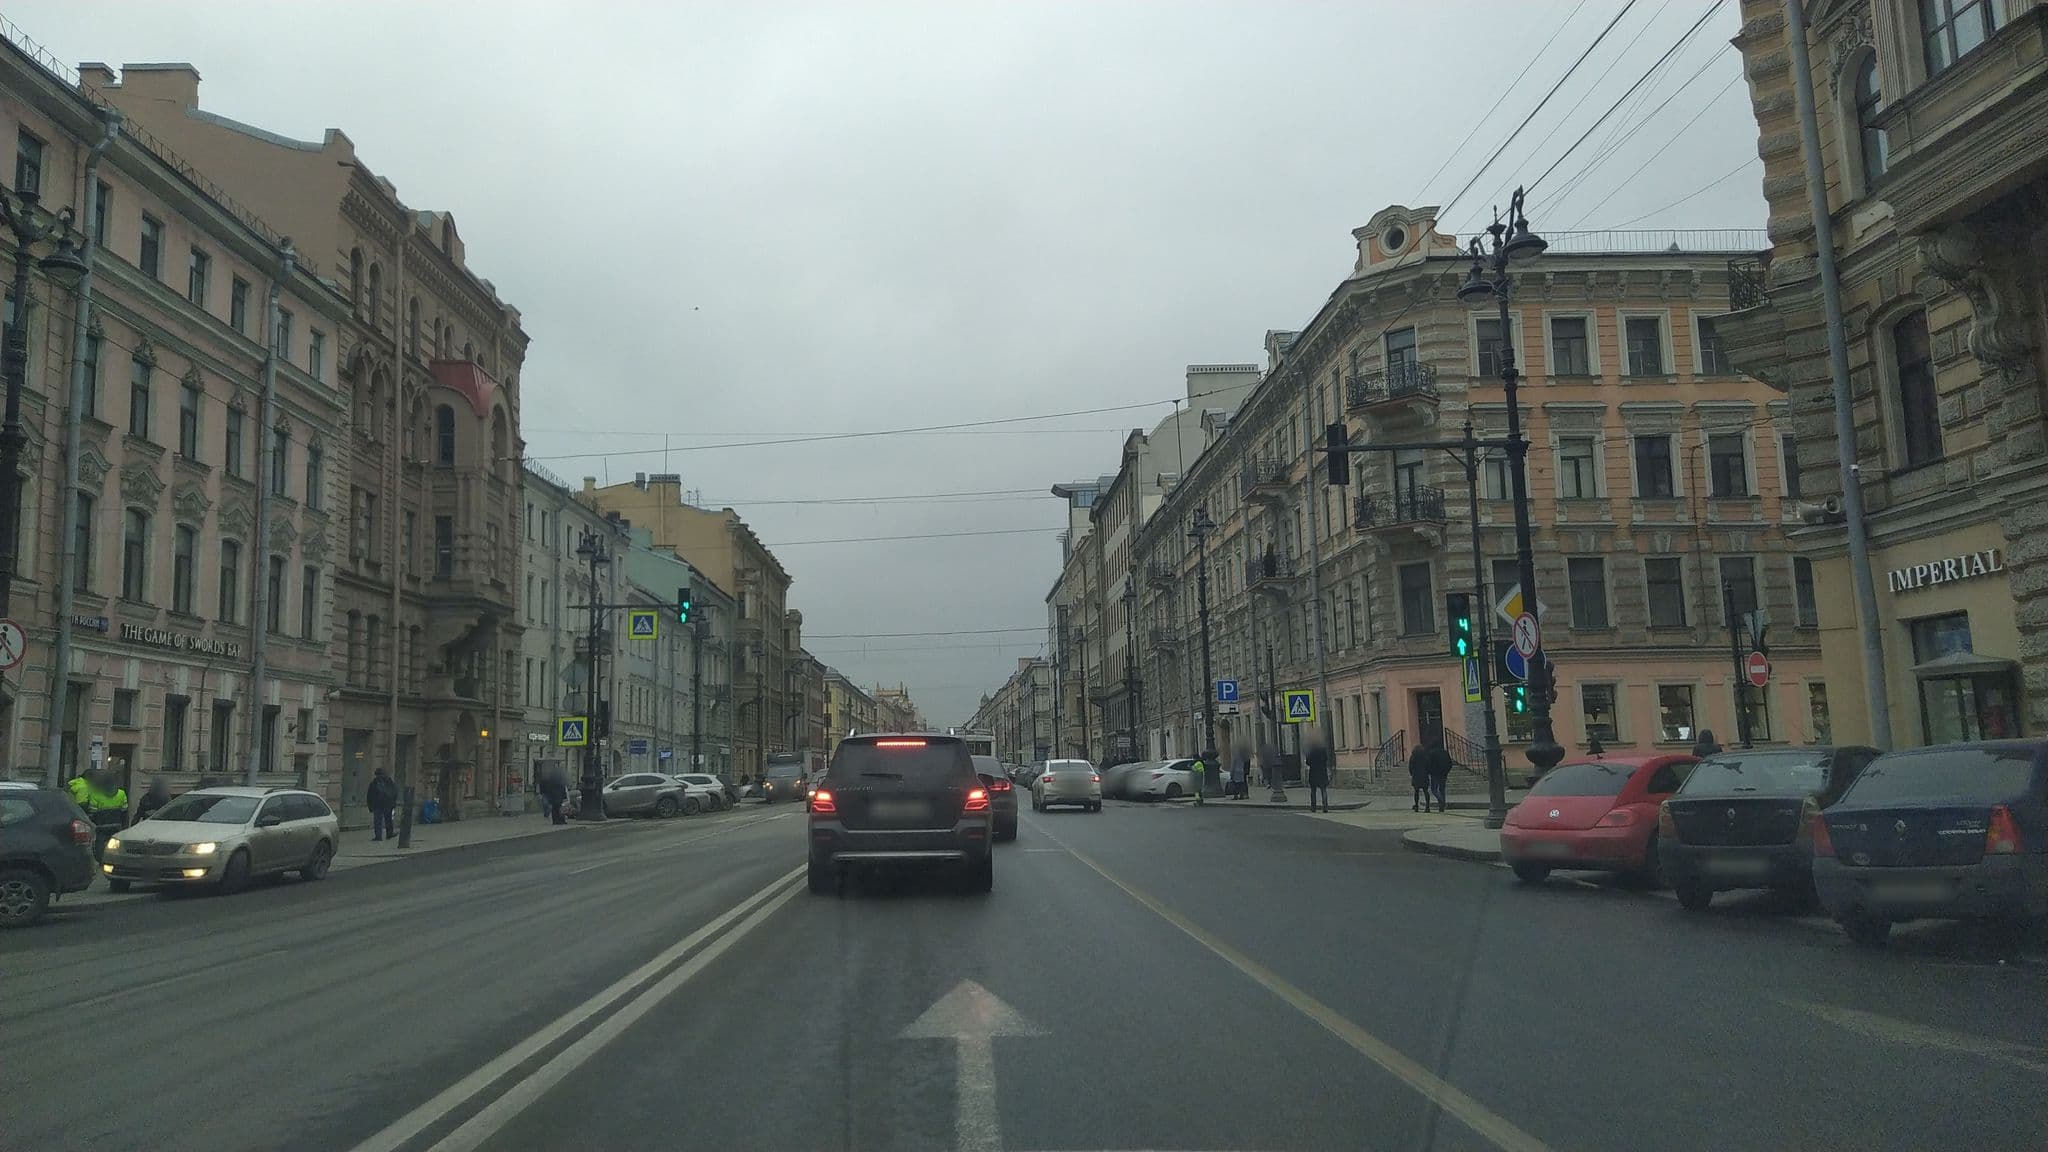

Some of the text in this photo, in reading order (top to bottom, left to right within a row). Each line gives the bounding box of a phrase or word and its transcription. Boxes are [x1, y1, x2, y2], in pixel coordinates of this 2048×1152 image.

[1888, 548, 2003, 592] IMPERIAL
[1459, 618, 1468, 631] 4
[124, 624, 143, 640] THE
[144, 627, 171, 646] GAME
[174, 633, 186, 648] OF
[190, 636, 225, 654] SWORDS
[1223, 682, 1234, 699] P
